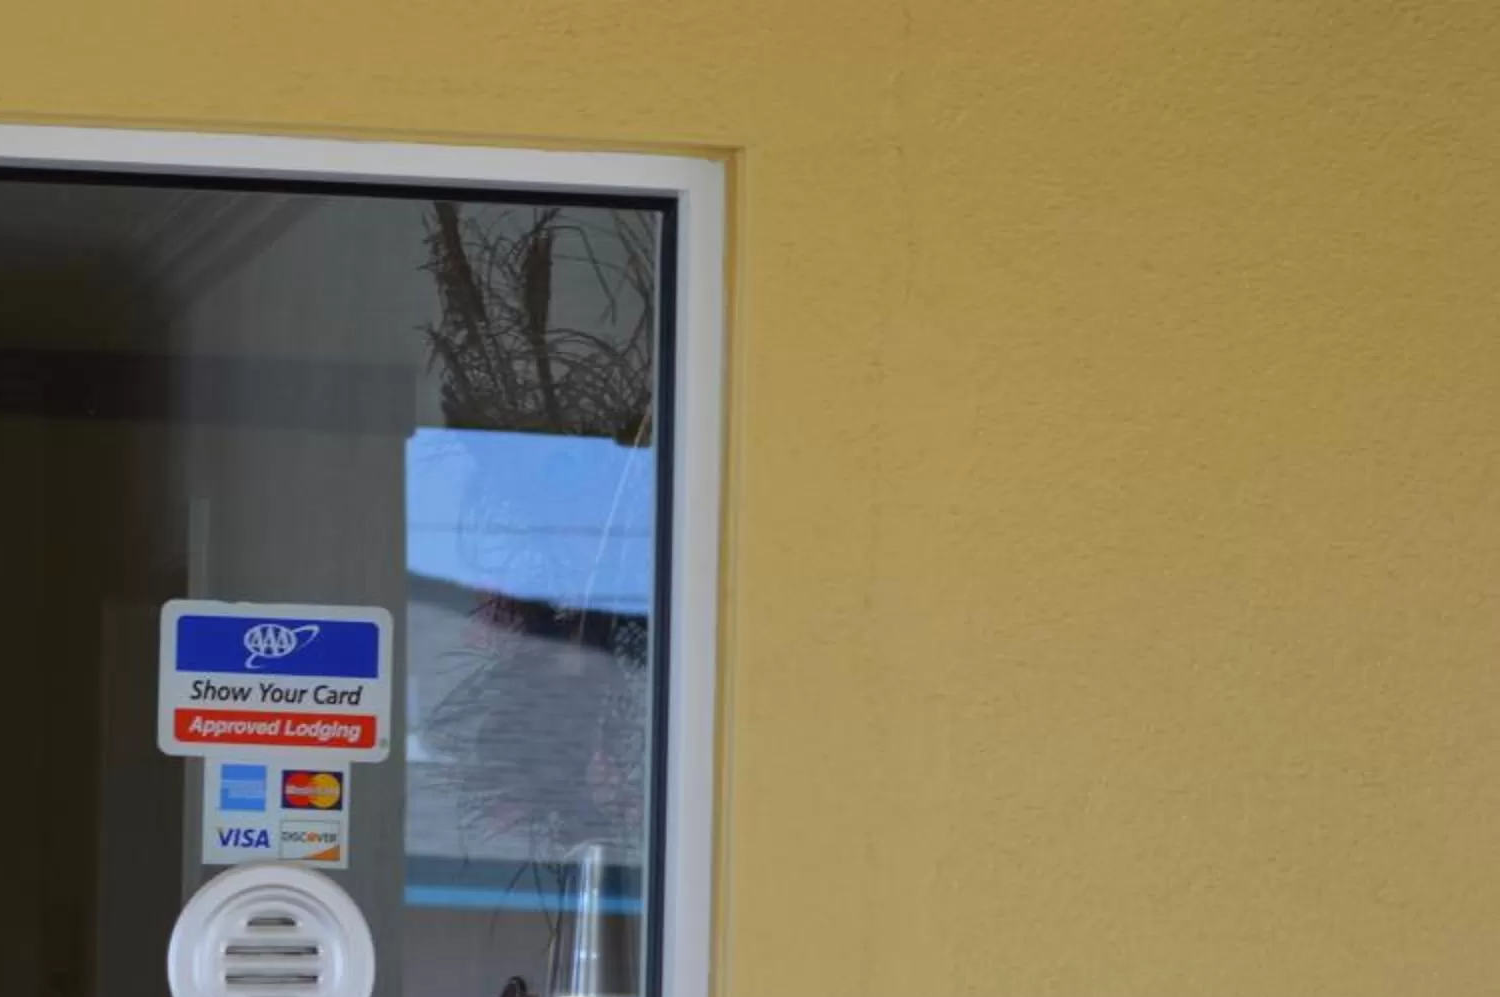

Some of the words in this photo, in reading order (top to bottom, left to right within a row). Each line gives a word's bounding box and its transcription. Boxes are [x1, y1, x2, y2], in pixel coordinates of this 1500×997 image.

[252, 627, 290, 650] AAA
[190, 679, 253, 702] Show
[259, 683, 308, 705] Your
[313, 685, 364, 705] Card
[189, 716, 280, 737] Approved
[284, 719, 361, 742] Lodging
[217, 828, 271, 848] VISA
